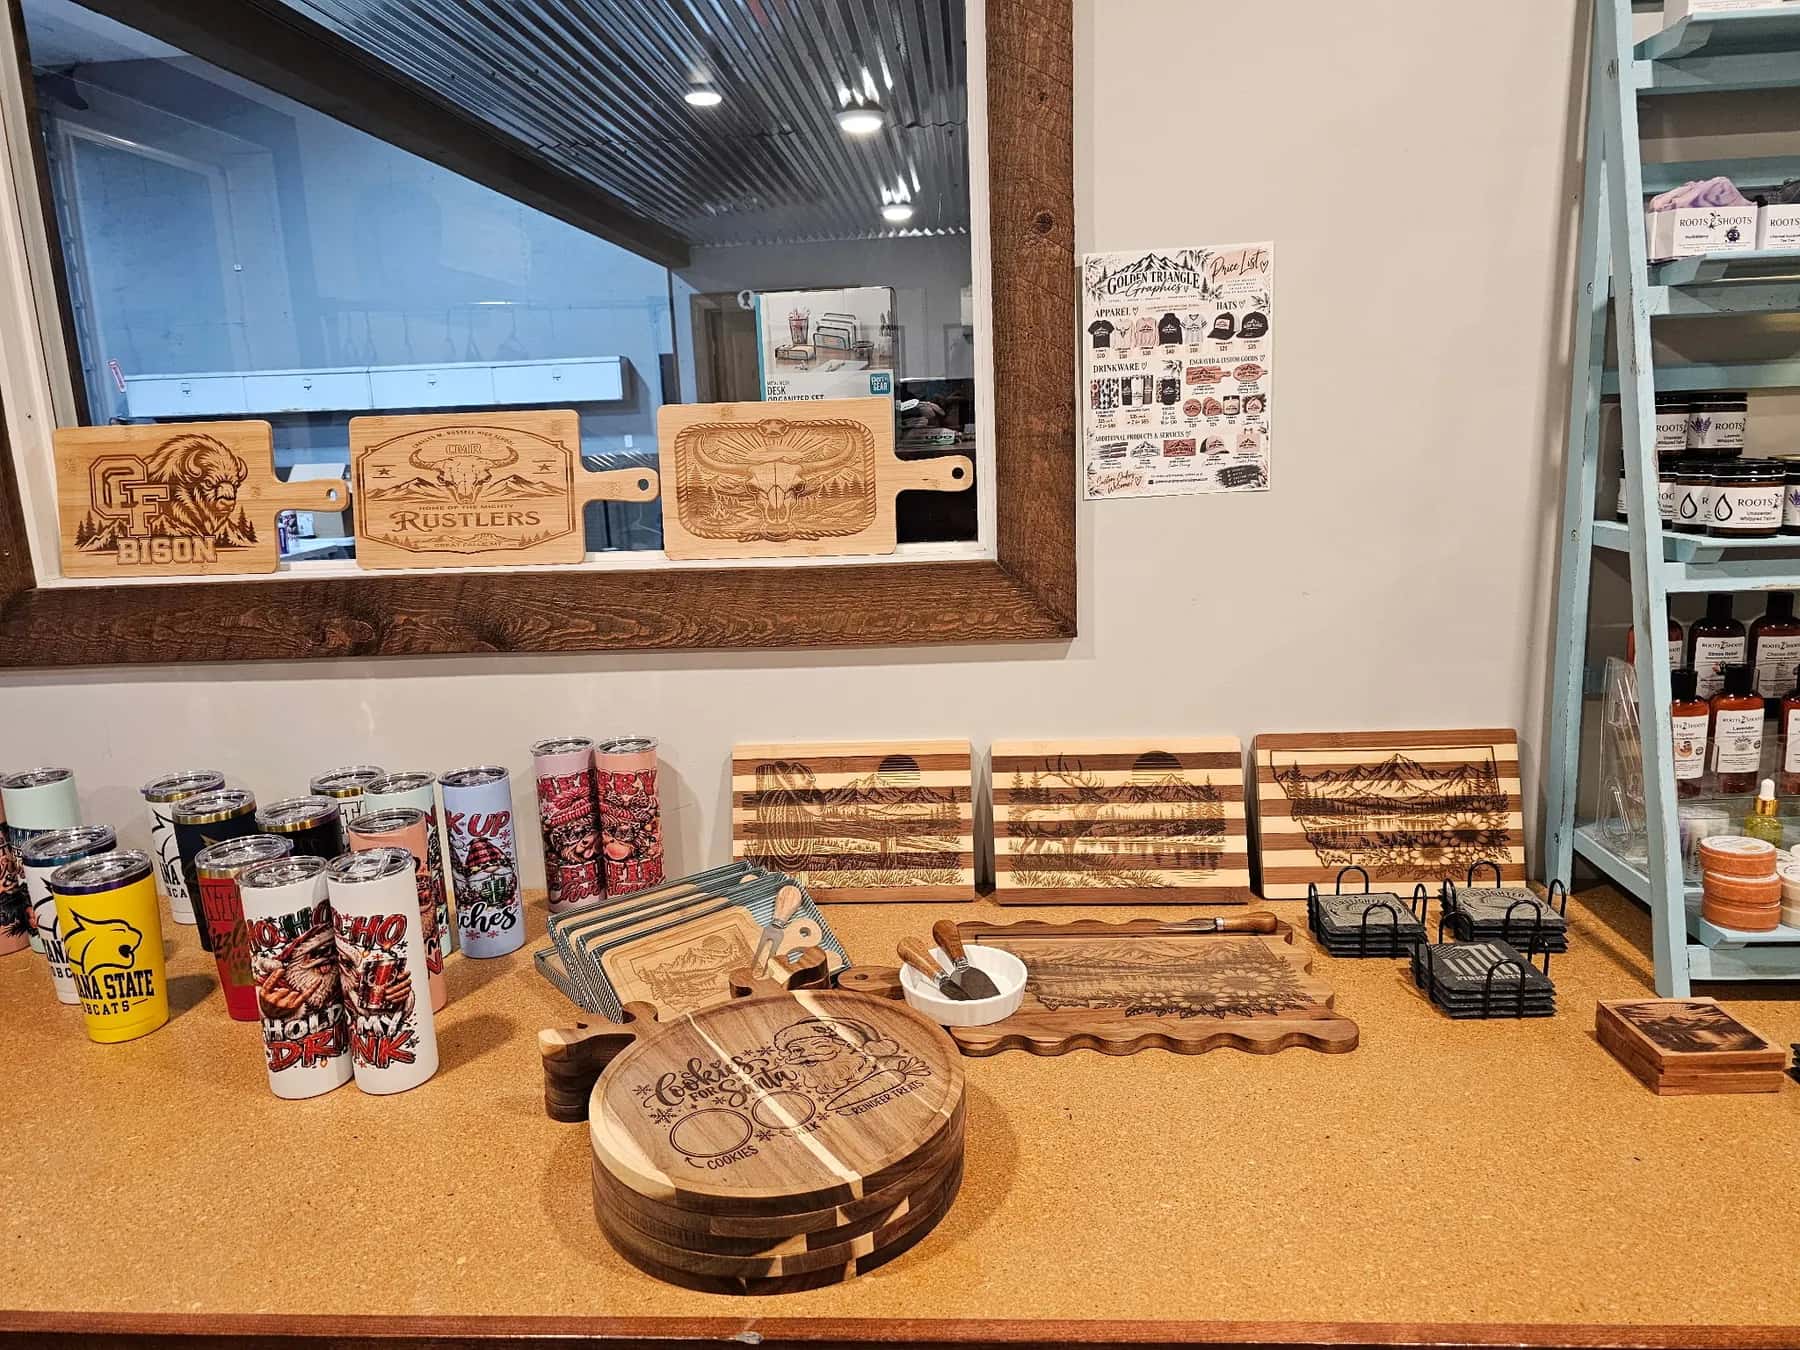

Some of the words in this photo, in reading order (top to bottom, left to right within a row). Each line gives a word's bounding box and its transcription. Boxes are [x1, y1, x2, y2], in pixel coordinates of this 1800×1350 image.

[1680, 218, 1709, 227] ROOTS
[1718, 216, 1753, 225] SHOOTS
[1210, 255, 1240, 280] Price
[1240, 250, 1266, 276] List
[1107, 271, 1148, 295] GOLDEN
[1150, 271, 1200, 289] TRIANGLE
[1115, 280, 1183, 297] Graphics
[1094, 307, 1130, 318] APPAREL
[1216, 300, 1238, 310] HATS
[1093, 362, 1140, 373] DRINKWARE
[767, 386, 786, 395] DESK
[1126, 432, 1153, 440] PRODUCTS
[1656, 424, 1683, 432] ROOTS
[1715, 422, 1742, 430] ROOTS
[1737, 498, 1773, 507] ROOTS
[388, 510, 541, 532] RUSTLERS
[117, 535, 218, 565] BISON
[467, 810, 511, 838] UP
[103, 968, 155, 1000] STATE
[356, 1011, 402, 1038] MY
[650, 1056, 766, 1108] Cookies
[688, 1085, 718, 1102] FOR
[717, 1067, 797, 1108] Santa
[851, 1093, 892, 1116] REINDEER
[891, 1079, 925, 1098] TREATS
[706, 1145, 760, 1171] COOKIES
